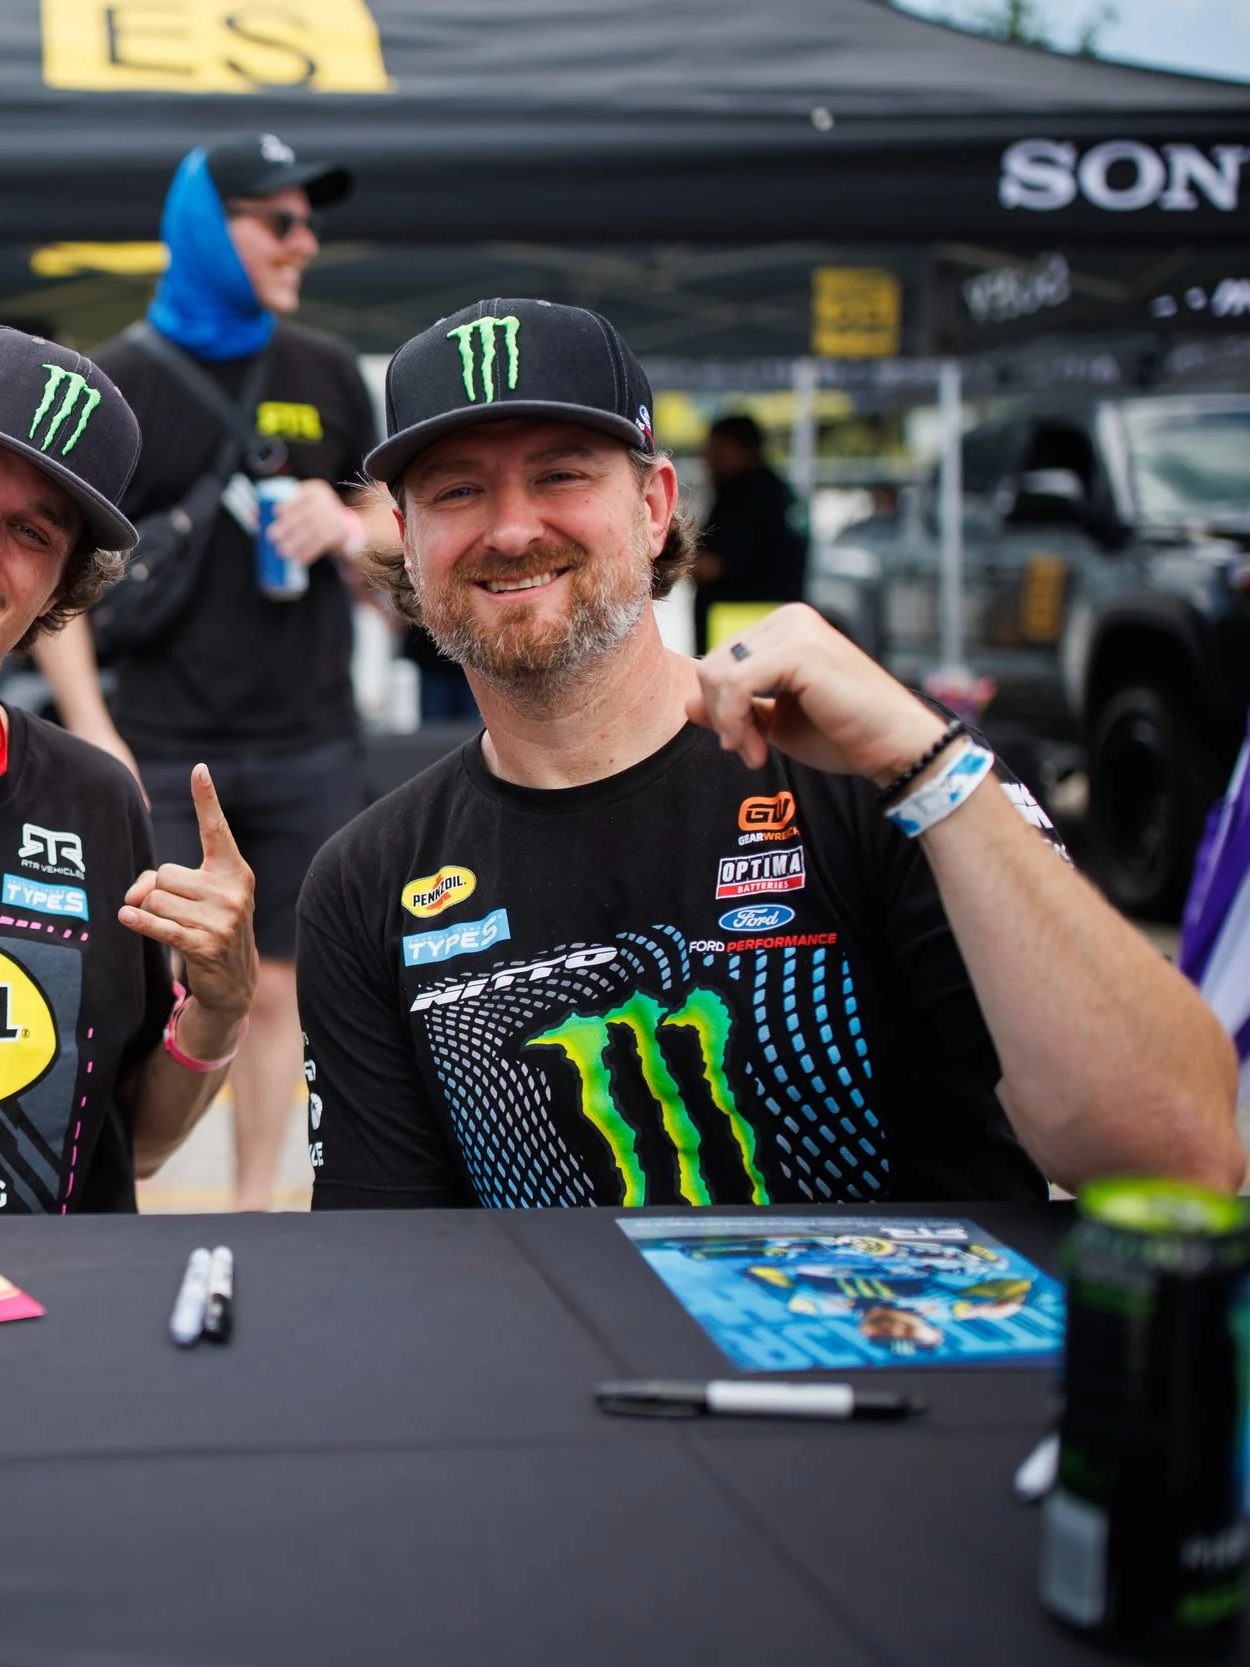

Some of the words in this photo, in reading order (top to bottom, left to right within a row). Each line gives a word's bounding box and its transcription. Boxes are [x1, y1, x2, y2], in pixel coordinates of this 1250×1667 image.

[104, 2, 318, 88] ES
[998, 137, 1250, 212] SON
[18, 822, 86, 873] RTR
[737, 827, 801, 846] GEARWRE
[21, 858, 40, 871] RTR
[721, 852, 802, 883] OPTIMA
[412, 874, 468, 907] PENNZOIL
[737, 880, 789, 894] BATTERIES
[732, 907, 781, 928] Ford
[688, 940, 725, 953] FORD
[726, 933, 838, 953] PERFORMANCE
[409, 946, 618, 1012] NITTO
